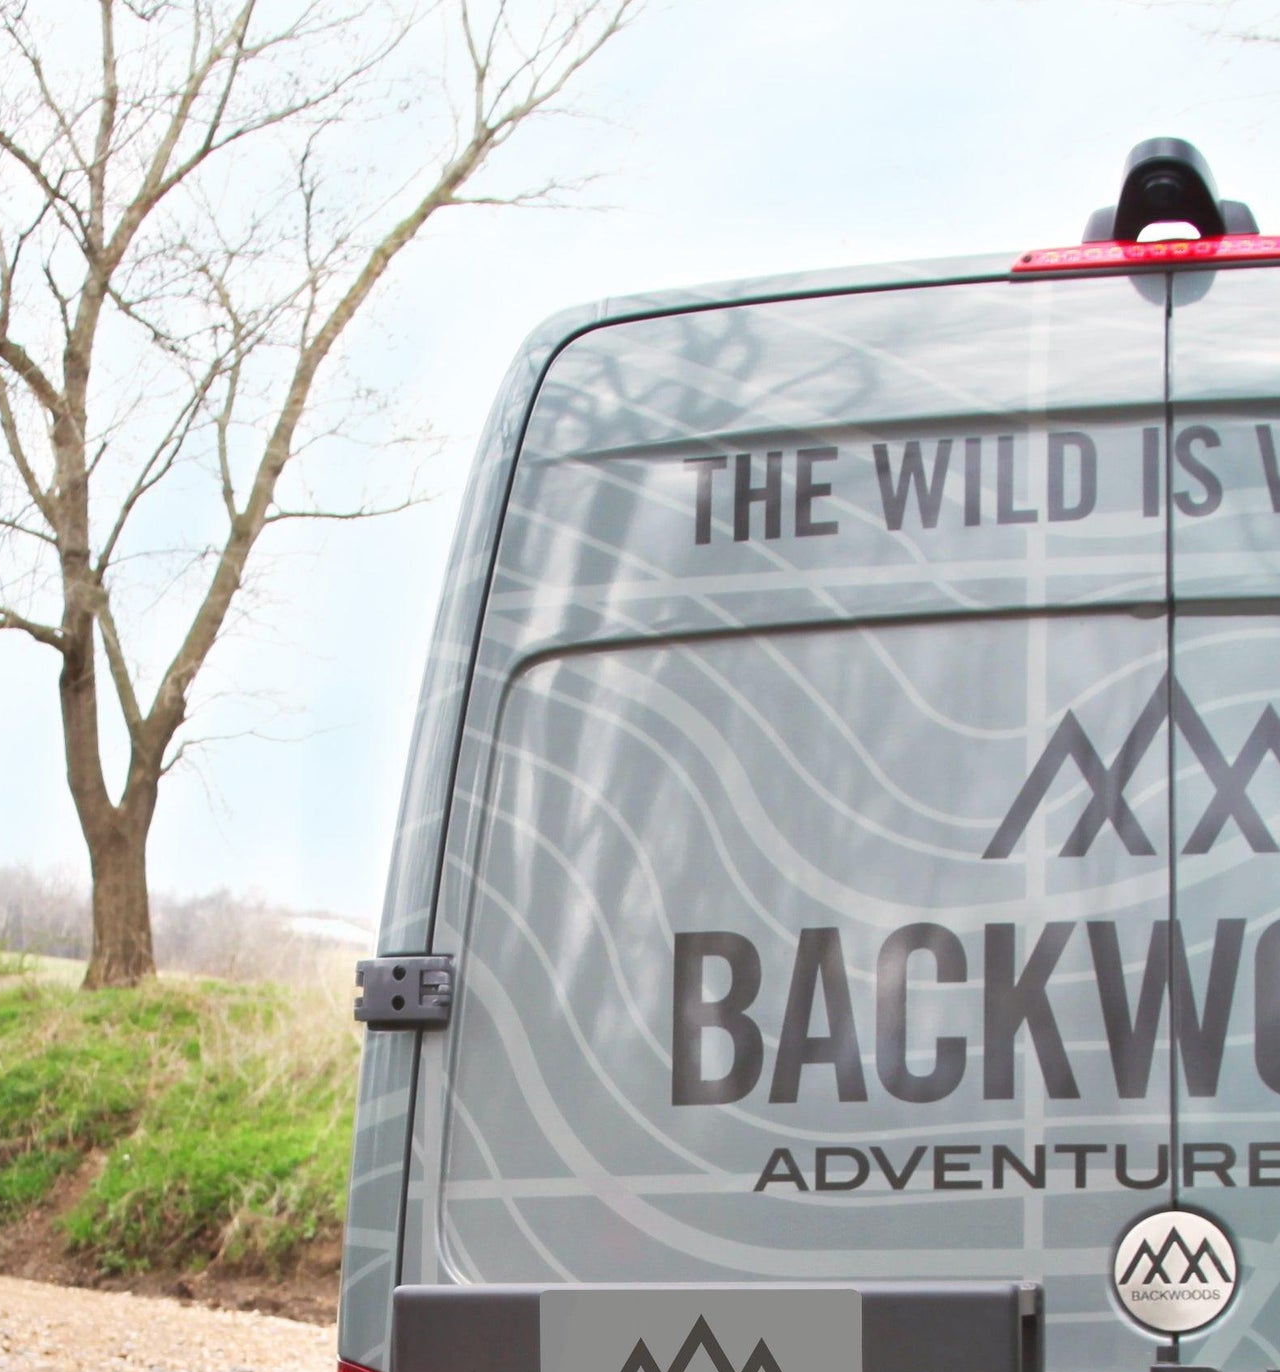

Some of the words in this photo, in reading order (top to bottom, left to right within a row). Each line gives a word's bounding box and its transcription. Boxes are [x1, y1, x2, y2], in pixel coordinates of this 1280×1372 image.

[683, 446, 839, 545] THE
[873, 430, 1098, 530] WILD
[1143, 425, 1223, 519] IS
[1131, 1289, 1221, 1301] BACKWOODS
